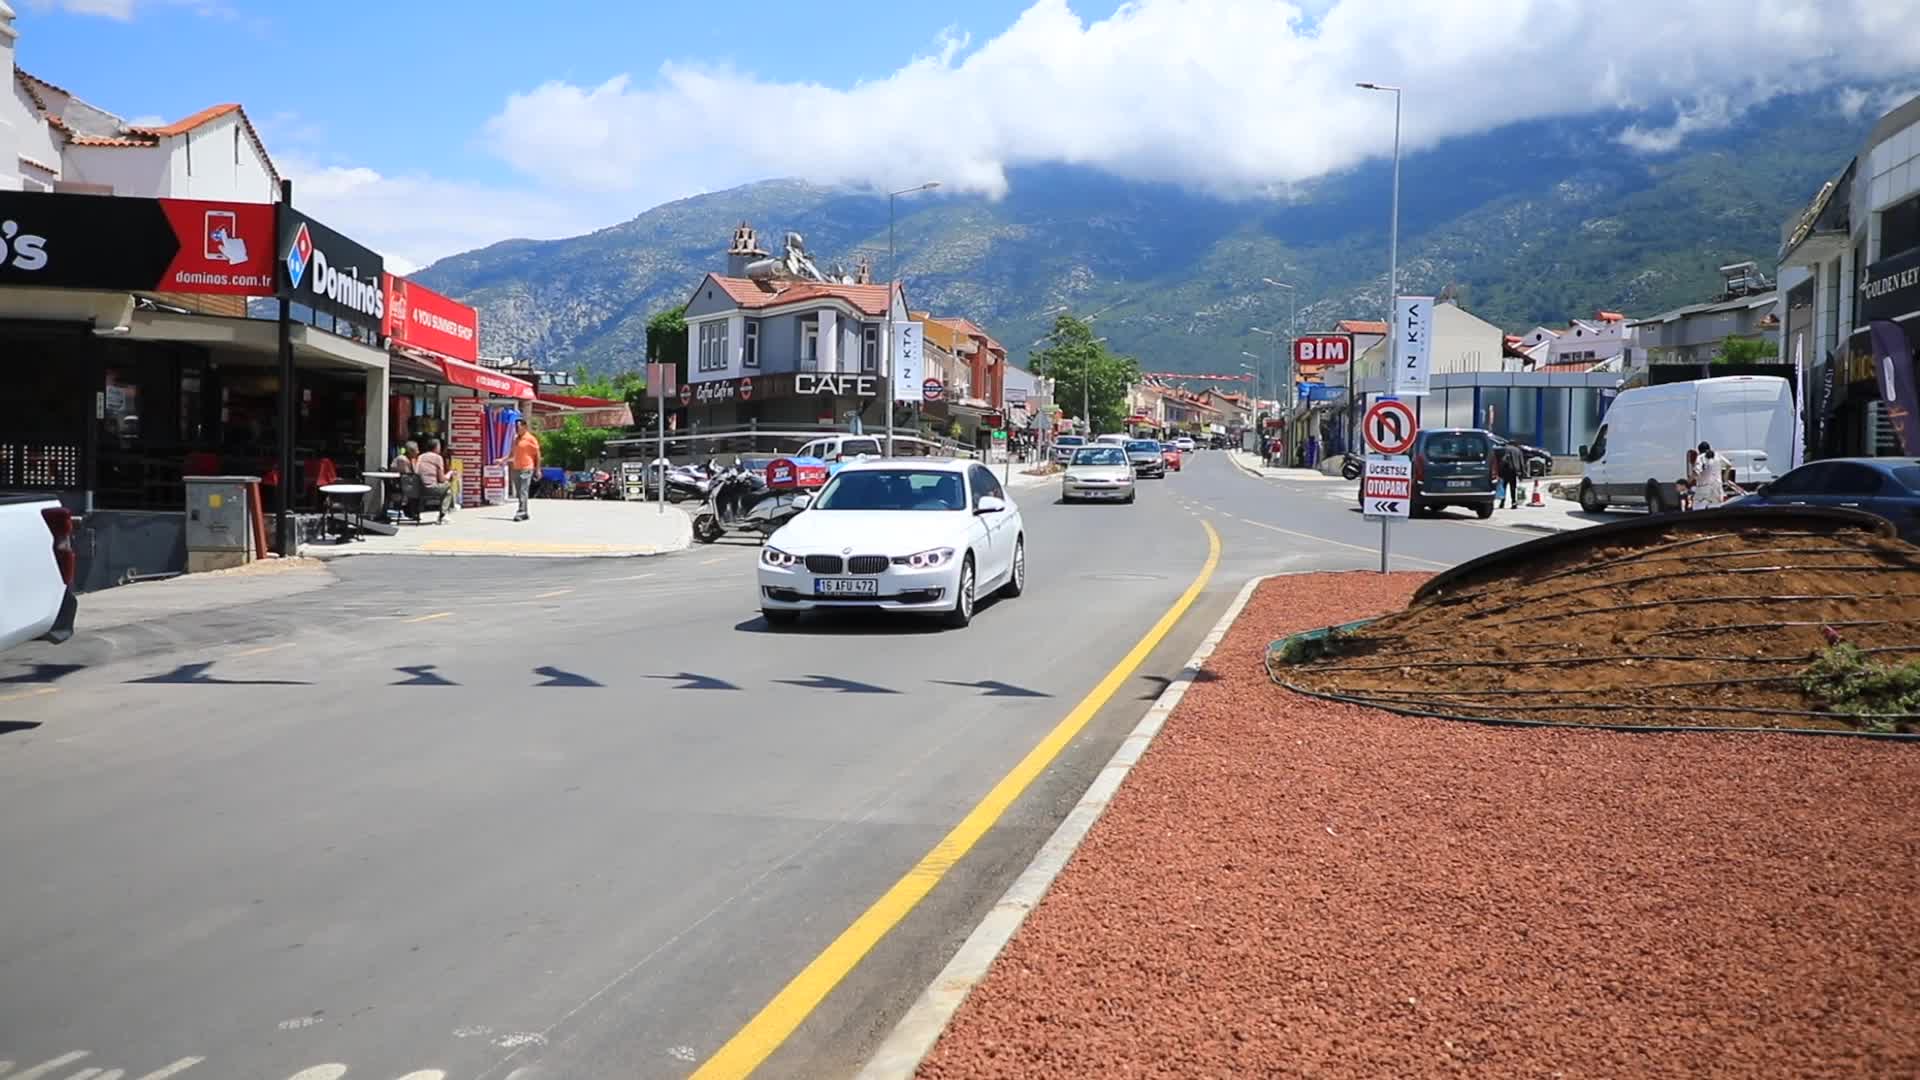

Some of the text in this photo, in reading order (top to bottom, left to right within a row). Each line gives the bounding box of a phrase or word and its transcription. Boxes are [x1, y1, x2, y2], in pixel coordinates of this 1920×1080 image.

[175, 270, 272, 287] dominos.com.tr
[312, 247, 384, 319] Domino's
[1865, 274, 1899, 299] GOLDEN
[1300, 338, 1345, 361] BİM
[795, 373, 877, 396] CAFE
[1367, 479, 1408, 497] OTOPARK
[821, 580, 874, 592] 16 AFU 472
